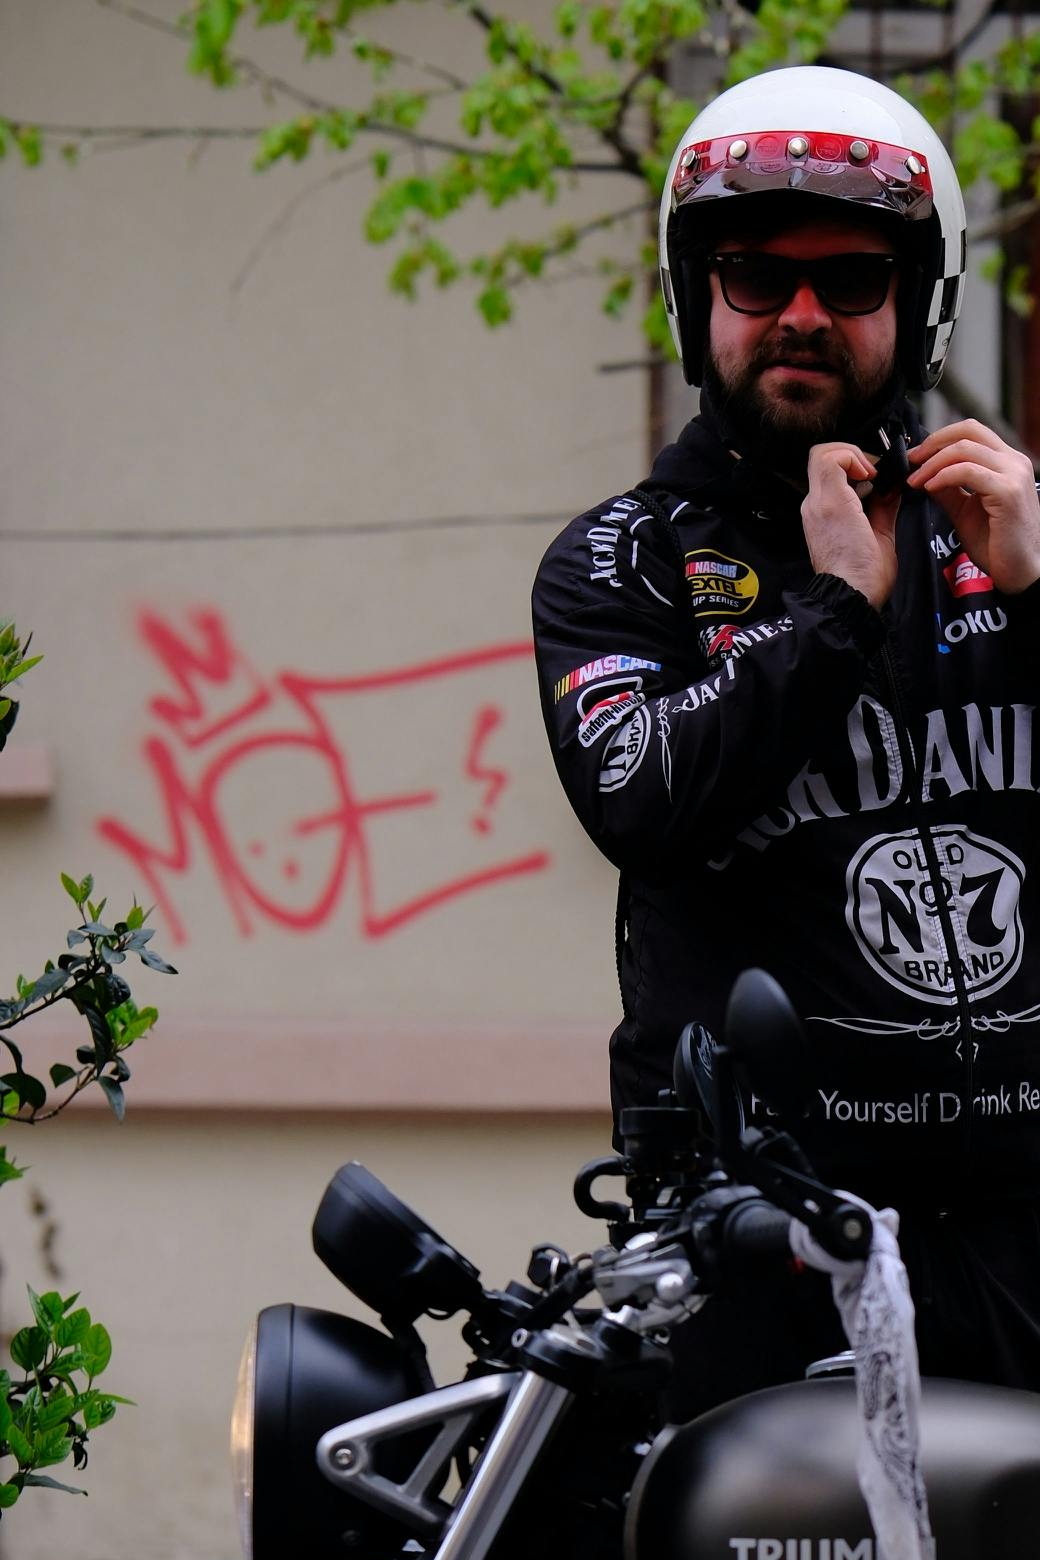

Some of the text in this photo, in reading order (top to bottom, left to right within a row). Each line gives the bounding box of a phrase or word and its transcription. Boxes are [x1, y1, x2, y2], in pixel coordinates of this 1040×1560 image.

[694, 560, 738, 579] NASCAR
[892, 842, 965, 872] OLD
[903, 951, 1005, 988] BRAND
[818, 1086, 929, 1124] Yourself
